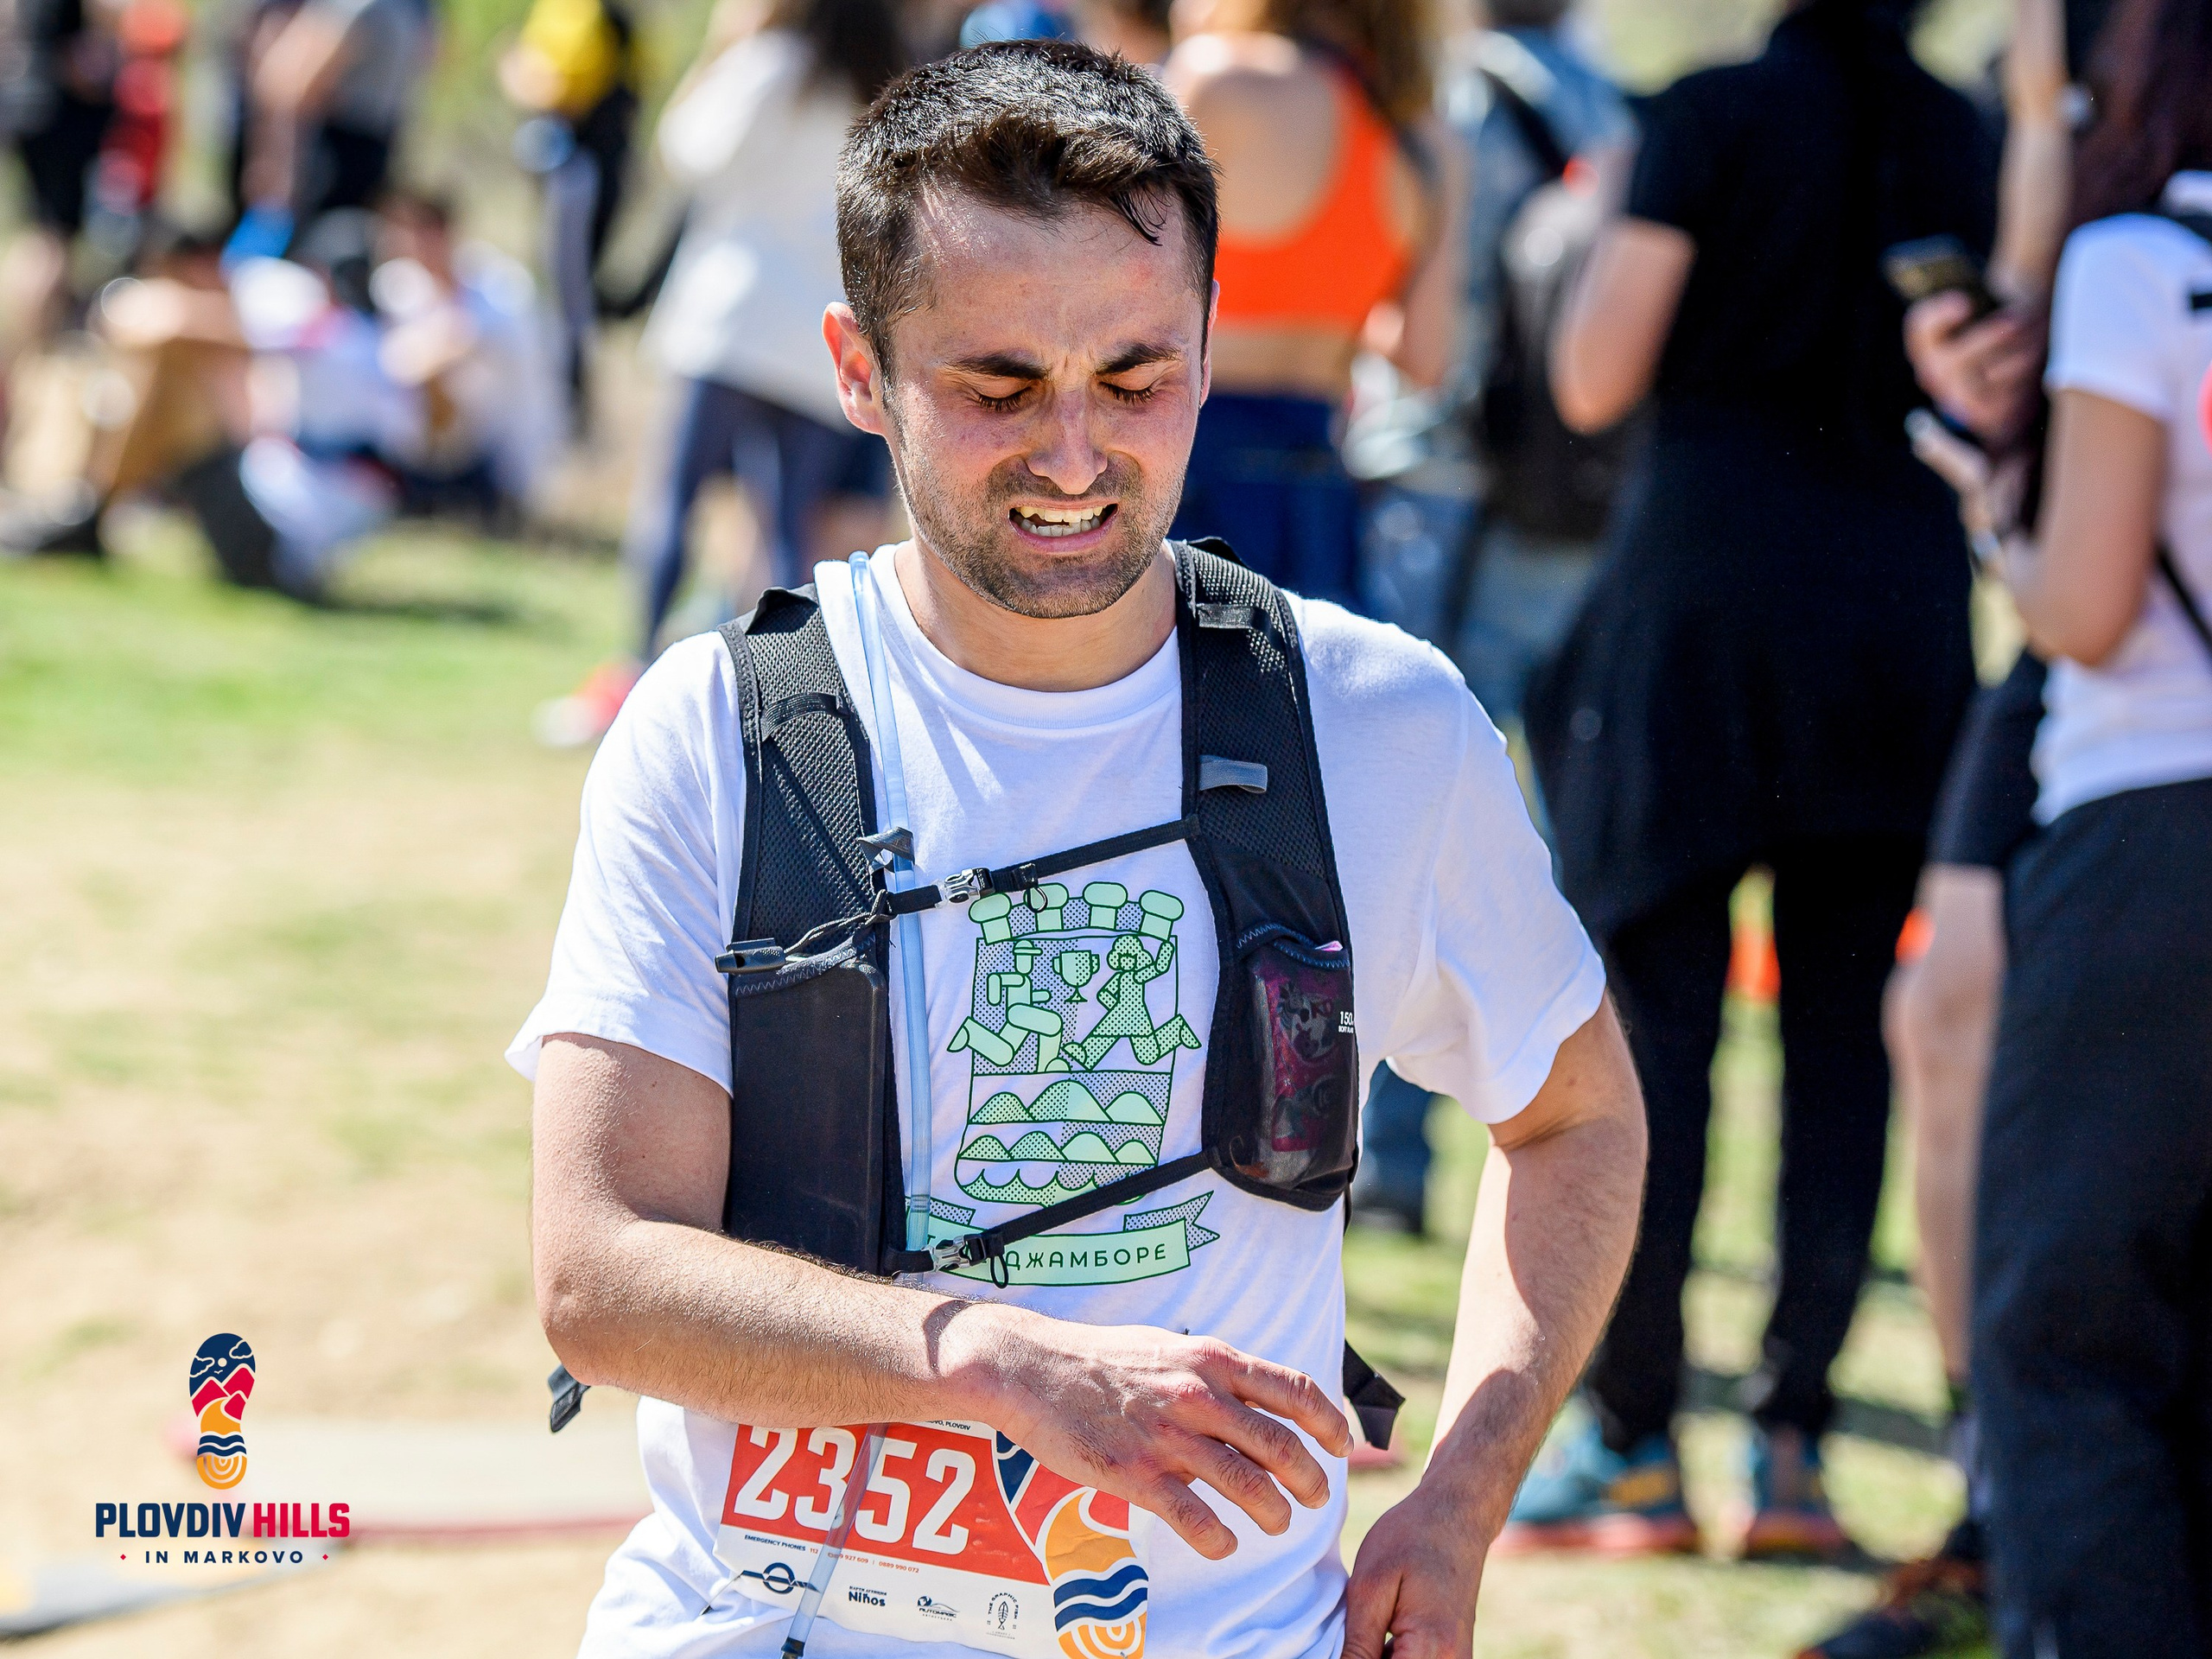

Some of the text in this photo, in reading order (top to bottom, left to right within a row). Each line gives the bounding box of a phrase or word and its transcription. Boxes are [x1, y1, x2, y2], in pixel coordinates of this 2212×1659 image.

[1004, 1243, 1166, 1271] ДЖАМБОРЕ
[945, 1421, 971, 1431] PLOVDIV
[734, 1426, 976, 1555] 2352
[744, 1535, 781, 1547] EMERGENCY
[781, 1541, 806, 1552] PHONES
